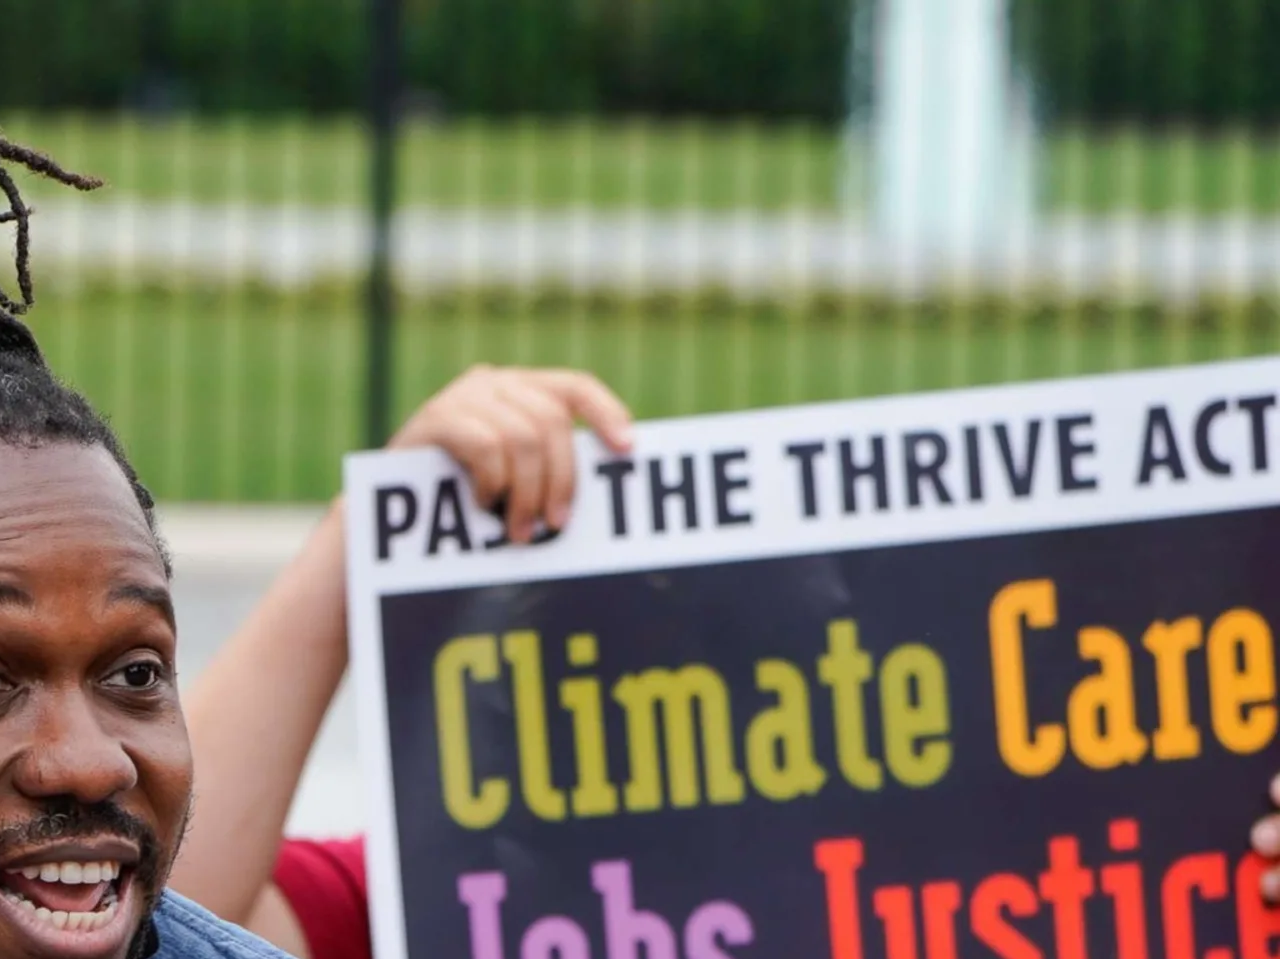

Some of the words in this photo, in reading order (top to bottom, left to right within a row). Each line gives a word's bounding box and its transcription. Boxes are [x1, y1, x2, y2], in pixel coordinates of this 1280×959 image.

[375, 474, 562, 561] PA
[596, 450, 754, 538] THE
[787, 415, 1097, 519] THRIVE
[1138, 395, 1277, 485] ACT
[434, 620, 952, 829] Climate
[988, 578, 1278, 777] Care
